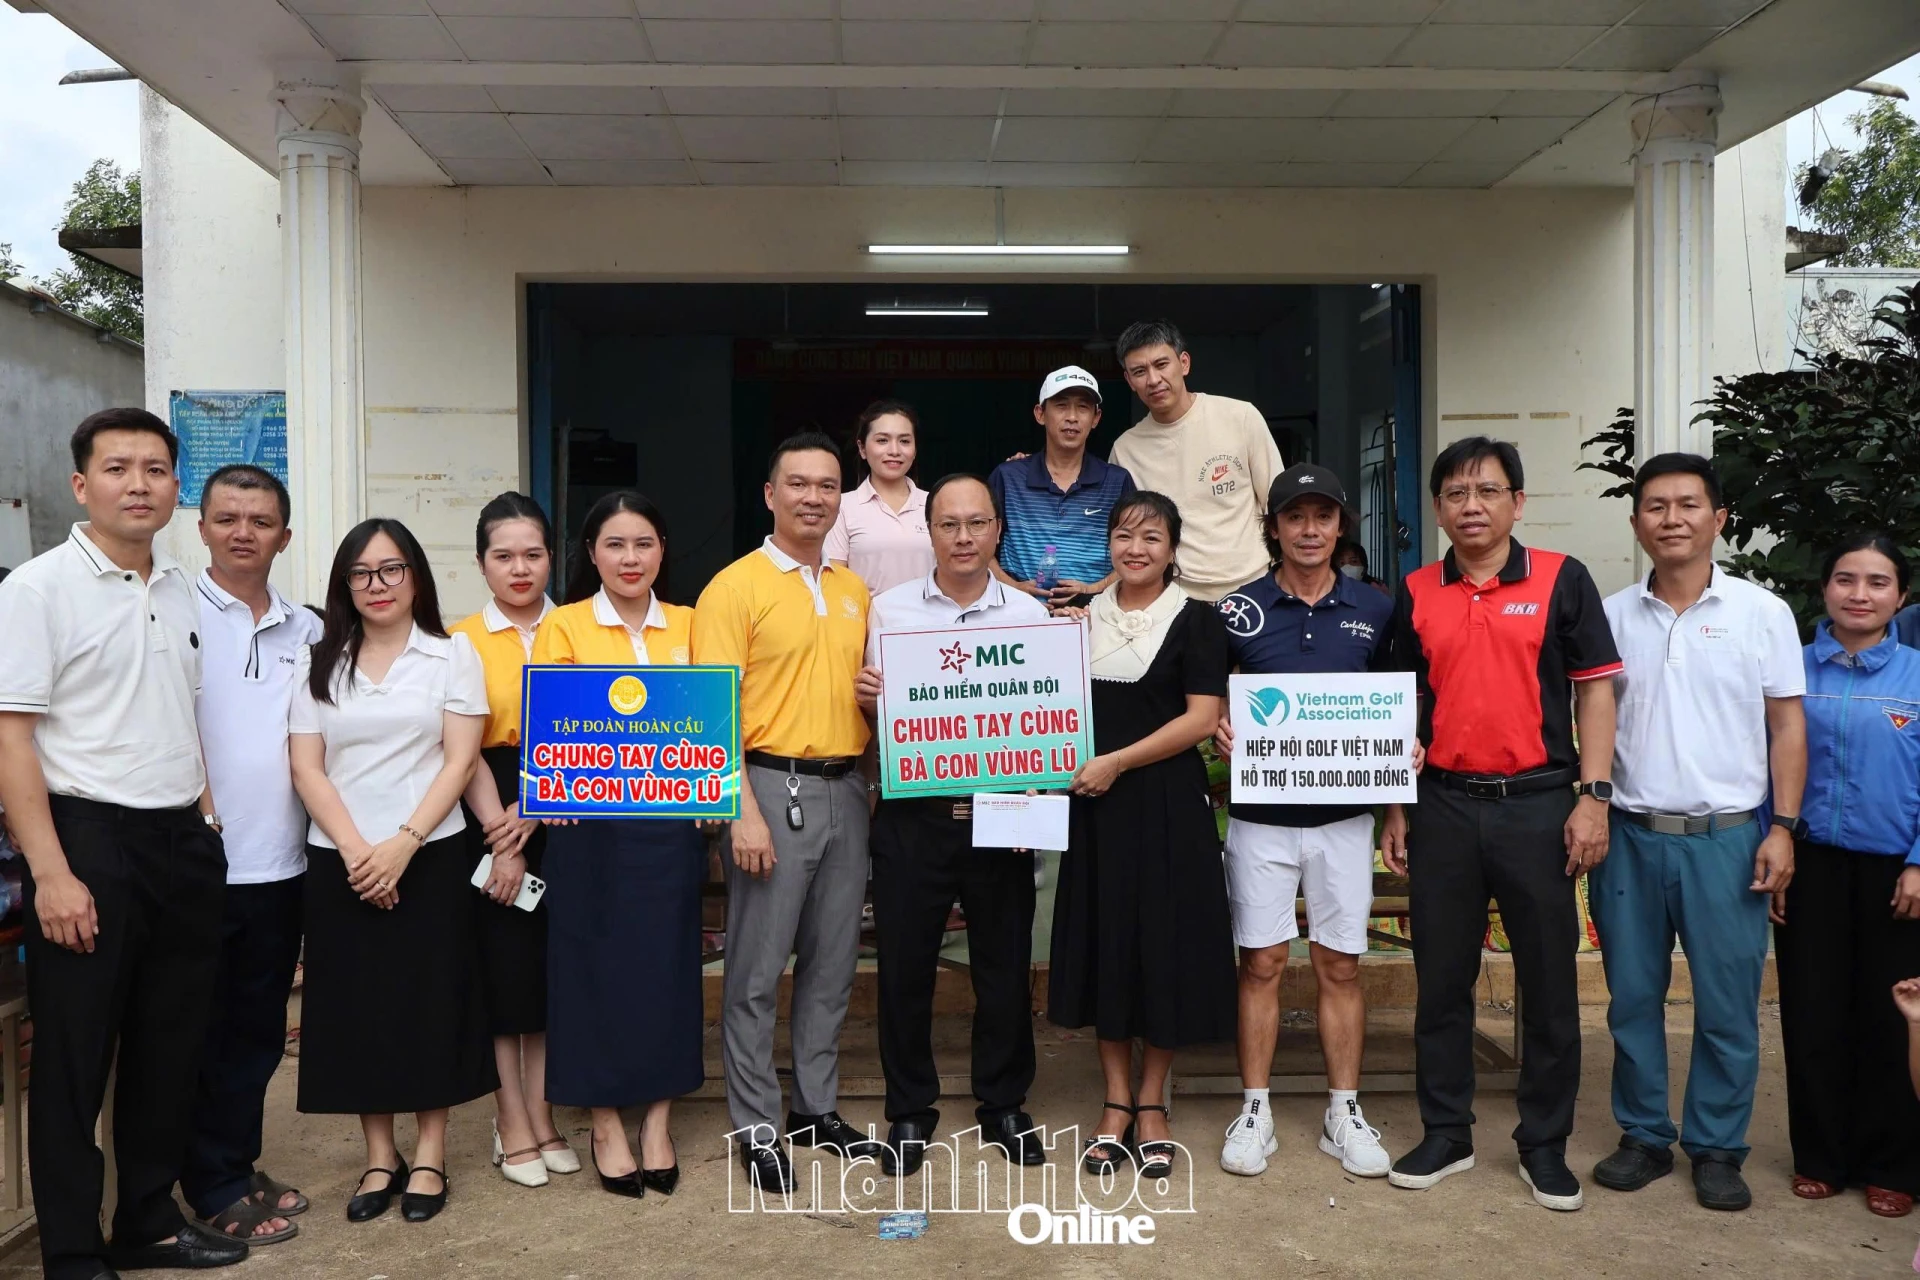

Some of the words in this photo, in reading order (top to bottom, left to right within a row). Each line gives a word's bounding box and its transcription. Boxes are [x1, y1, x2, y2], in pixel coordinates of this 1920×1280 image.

[1205, 454, 1233, 468] ATHLETIC
[1214, 464, 1229, 475] NIKE
[1212, 480, 1235, 496] 1972
[975, 643, 1026, 668] MIC
[909, 682, 939, 702] BẢO
[944, 678, 983, 700] HIỂM
[988, 679, 1028, 699] QUÂN
[1033, 676, 1060, 698] ĐỘI
[1296, 692, 1364, 706] Vietnam
[1369, 692, 1404, 706] Golf
[553, 717, 579, 736] TẬP
[583, 717, 624, 733] ĐOÀN
[628, 717, 670, 734] HOÀN
[674, 716, 704, 733] CẦU
[893, 714, 968, 744] CHUNG
[973, 712, 1013, 739] TAY
[1020, 704, 1079, 736] CÙNG
[1296, 707, 1392, 721] Association
[534, 743, 614, 769] CHUNG
[619, 744, 657, 769] TAY
[661, 738, 727, 770] CÙNG
[1246, 736, 1276, 761] HIỆP
[1280, 736, 1302, 761] HỘI
[1306, 739, 1338, 757] GOLF
[1342, 736, 1369, 761] VIỆT
[1373, 739, 1404, 757] NAM
[899, 750, 929, 782] BÀ
[934, 752, 979, 780] CON
[985, 744, 1044, 776] VÙNG
[1050, 741, 1077, 773] LŨ
[537, 771, 567, 801] BÀ
[572, 776, 624, 802] CON
[627, 771, 692, 803] VÙNG
[696, 774, 722, 804] LŨ
[1241, 763, 1258, 788] HỖ
[1262, 769, 1287, 791] TRỢ
[1291, 769, 1371, 788] 150.000.000
[1374, 763, 1409, 788] ĐỒNG
